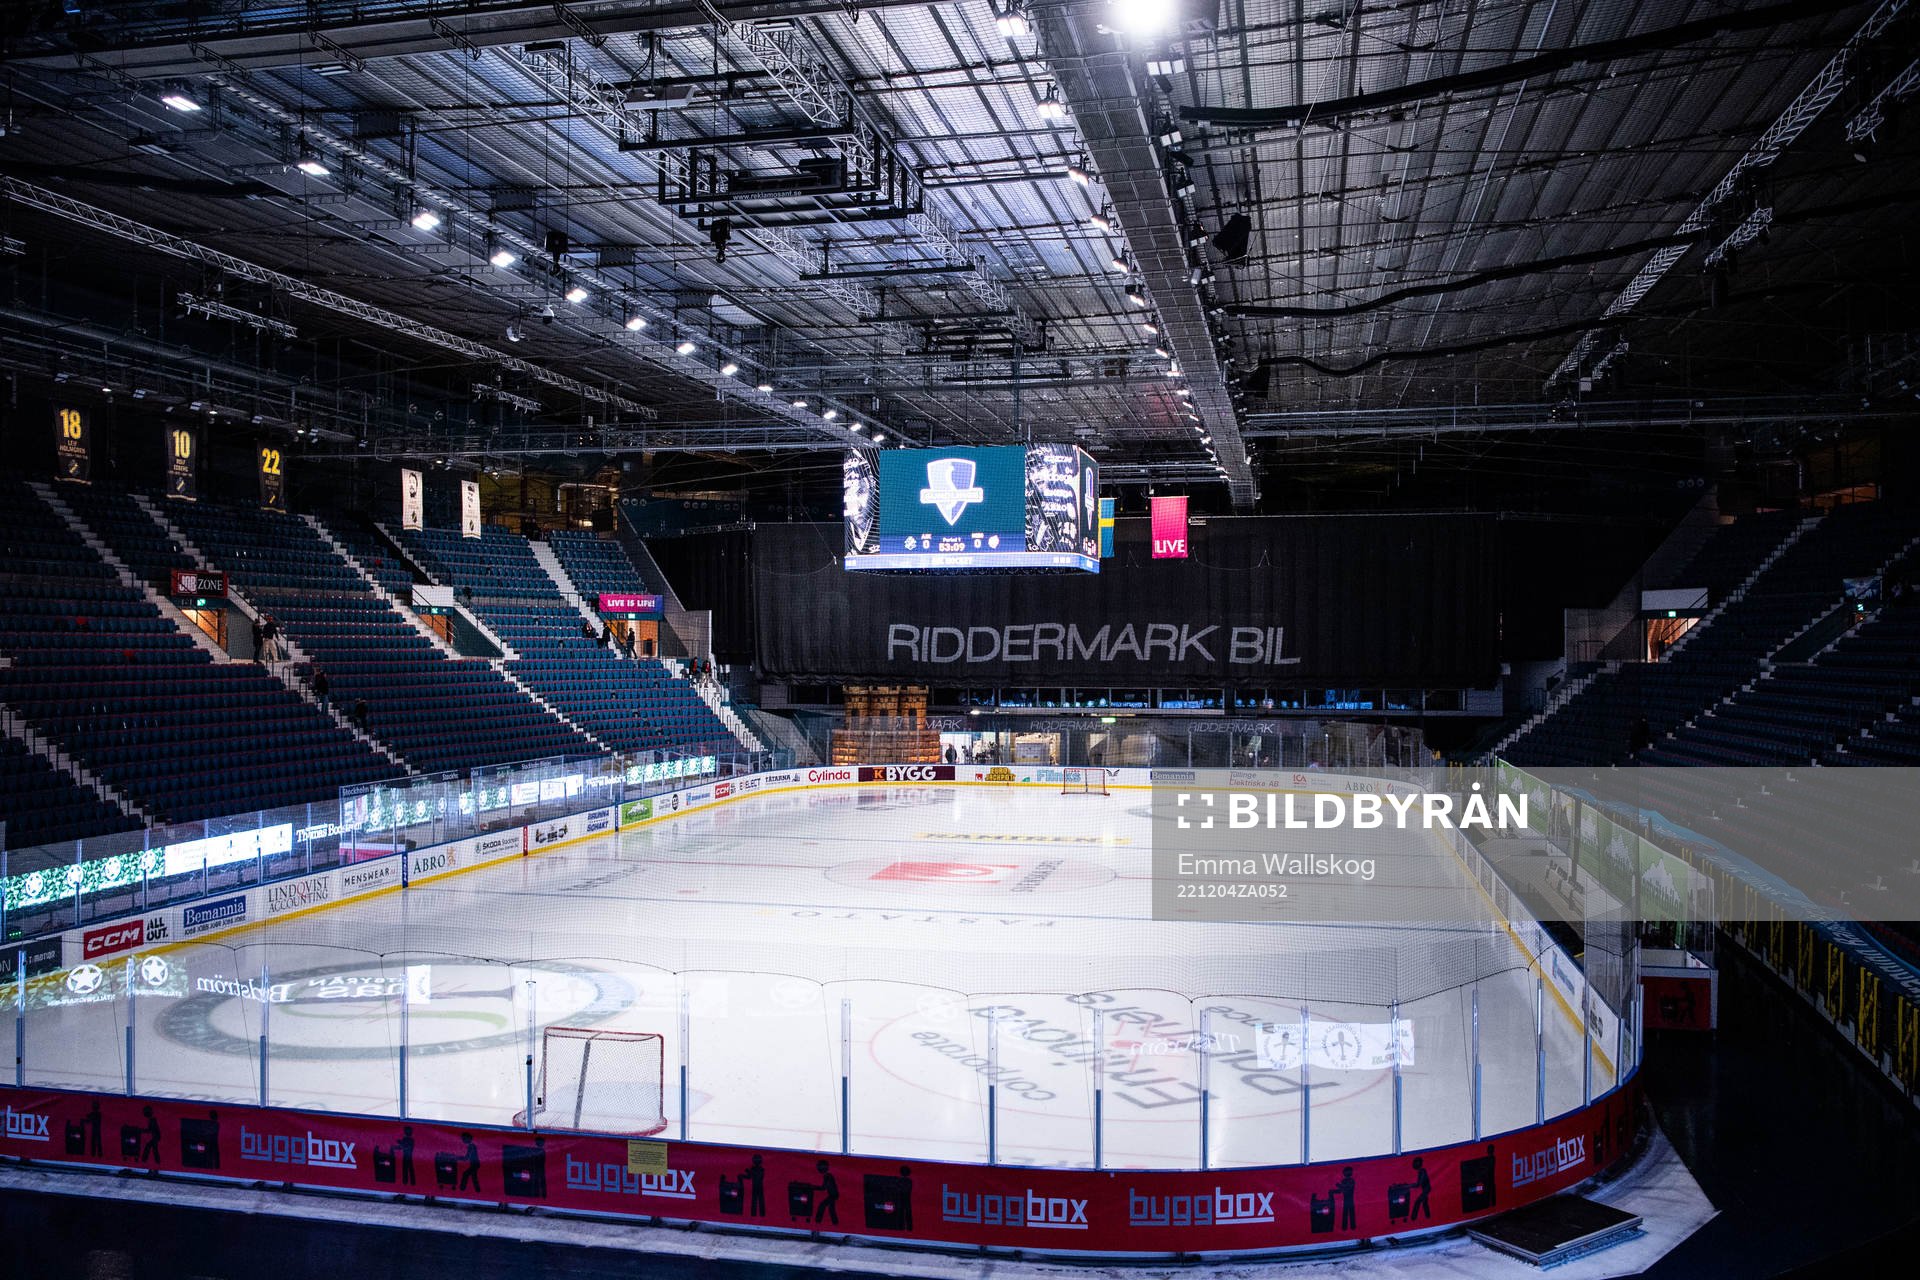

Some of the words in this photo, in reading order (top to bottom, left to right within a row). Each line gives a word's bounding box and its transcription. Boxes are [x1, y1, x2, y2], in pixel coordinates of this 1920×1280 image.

[60, 408, 82, 440] 18
[172, 430, 191, 459] 10
[262, 448, 281, 475] 22
[923, 540, 930, 549] 0
[939, 542, 965, 552] 53:09
[974, 539, 981, 548] 0
[1155, 539, 1185, 553] LIVE
[198, 579, 223, 591] ZONE
[607, 599, 625, 607] LIVE
[627, 599, 635, 607] IS
[887, 622, 1222, 664] RIDDERMARK
[1228, 626, 1301, 665] BIL
[808, 769, 850, 783] Cylinda
[886, 766, 936, 781] BYGG
[1269, 780, 1280, 788] AB
[1293, 774, 1307, 783] ICA
[268, 876, 330, 903] LINDQVIST
[268, 889, 329, 914] ACCOUNTING
[147, 916, 165, 933] ALL
[185, 898, 245, 926] Bemannia
[86, 927, 142, 952] CCM
[240, 1125, 357, 1169] byggbox
[1512, 1134, 1586, 1188] byggbox
[942, 1183, 1088, 1229] byggbox
[1129, 1186, 1275, 1226] byggbox
